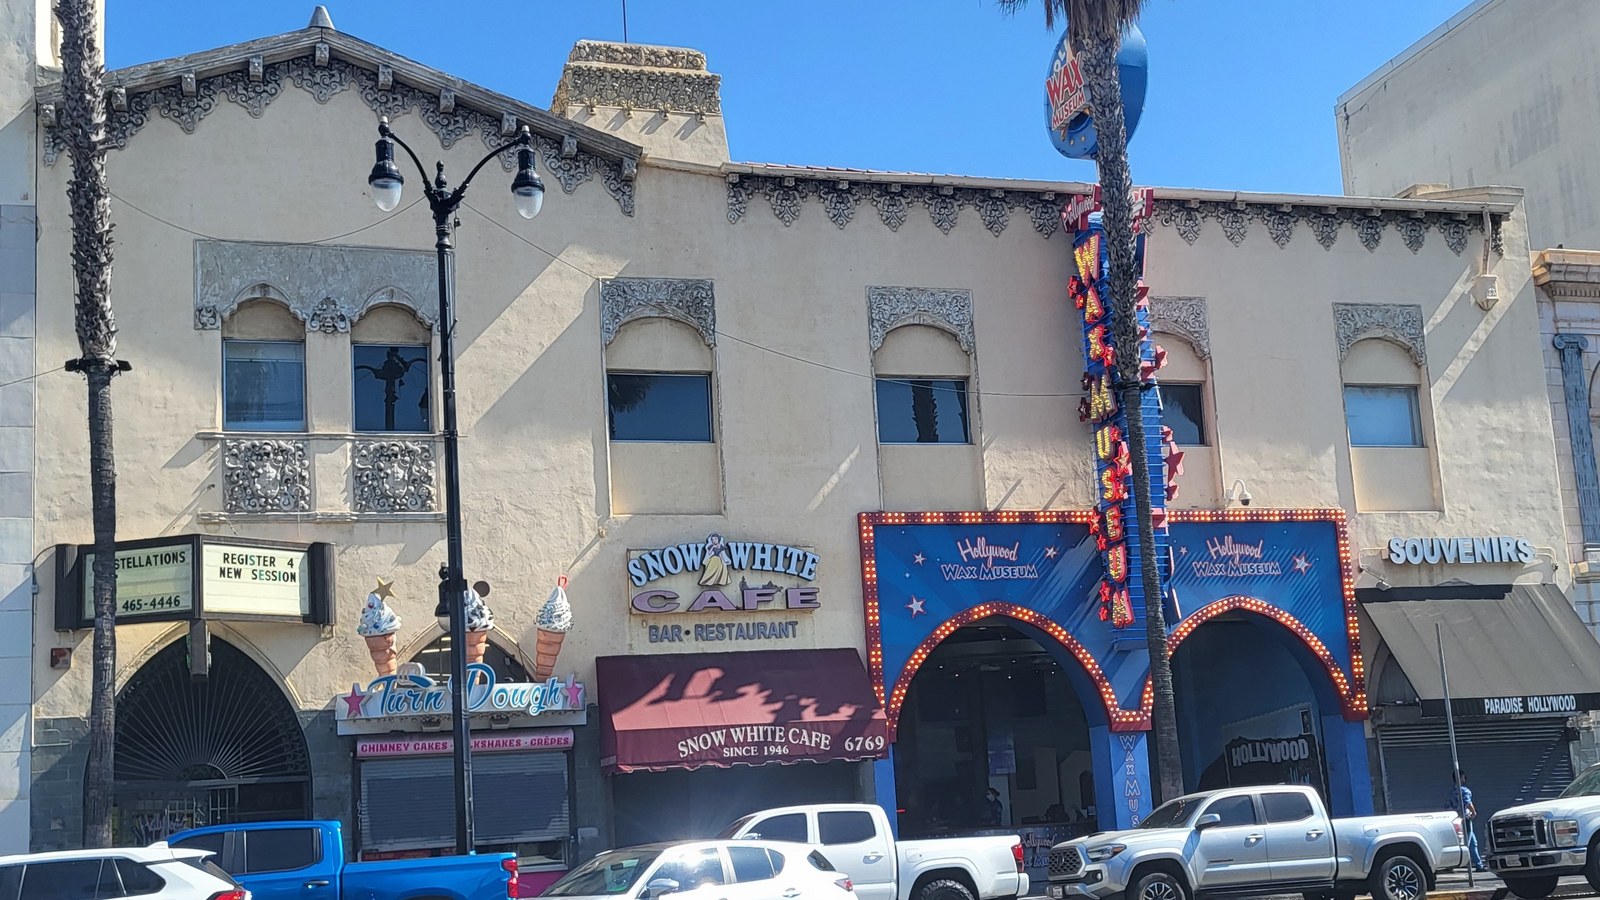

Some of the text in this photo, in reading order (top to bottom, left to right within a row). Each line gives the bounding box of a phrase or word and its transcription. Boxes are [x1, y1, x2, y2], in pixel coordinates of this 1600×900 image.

[1046, 52, 1084, 111] WAX
[1052, 88, 1086, 130] MUSEUM
[1074, 233, 1109, 362] WAX
[1090, 374, 1135, 629] MUSEUM
[92, 551, 186, 571] STELLATIONS
[223, 553, 294, 569] REGISTER 4
[628, 541, 821, 587] SNOW WHITE
[957, 536, 1019, 568] Hollywood
[1206, 535, 1263, 565] Hollywood
[1389, 536, 1536, 565] SOUVENIRS
[219, 567, 297, 583] NEW SESSION
[941, 563, 1039, 581] WAX MUSEUM
[1192, 560, 1282, 578] WAX MUSEUM
[122, 595, 181, 612] 465-4446
[632, 587, 821, 613] CAFE
[649, 621, 798, 643] BAR RESTAURANT
[367, 663, 561, 717] Turn Dough
[1484, 695, 1576, 714] PARADISE HOLLYWOOD
[361, 743, 410, 753] CHIMNEY
[413, 741, 448, 751] CAKES
[470, 738, 522, 749] KSHAKES
[678, 726, 885, 758] SNOW WHITE CAFE 6769
[723, 745, 789, 757] SINCE 1946
[1119, 735, 1136, 775] WAX
[1232, 739, 1309, 767] HOLLYWOOD
